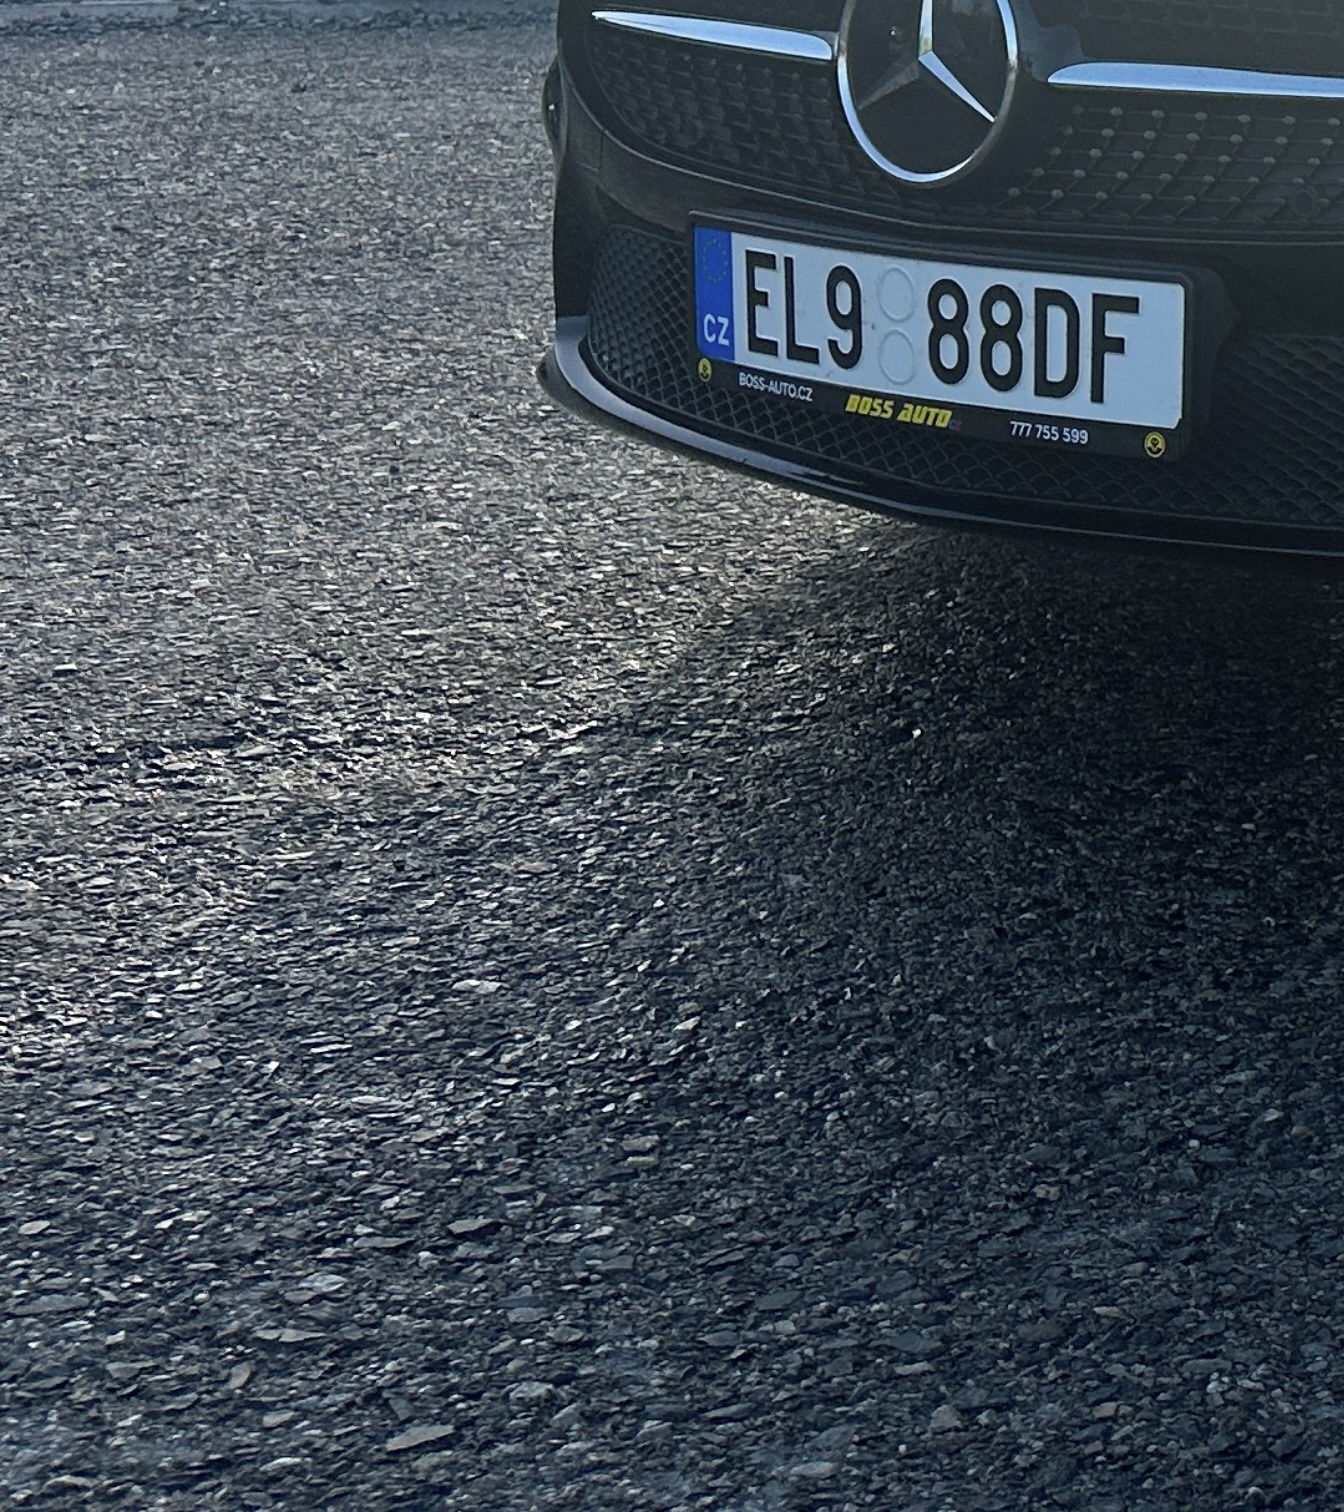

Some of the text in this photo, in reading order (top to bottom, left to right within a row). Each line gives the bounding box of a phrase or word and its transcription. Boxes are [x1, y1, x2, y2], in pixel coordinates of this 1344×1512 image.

[703, 313, 730, 347] CZ
[745, 248, 1140, 404] EL9 88DF
[738, 372, 814, 402] BOSS-AUTO.CZ
[845, 394, 895, 419] BOSS
[897, 403, 953, 429] AUTO
[1010, 420, 1089, 445] 777 755 599
